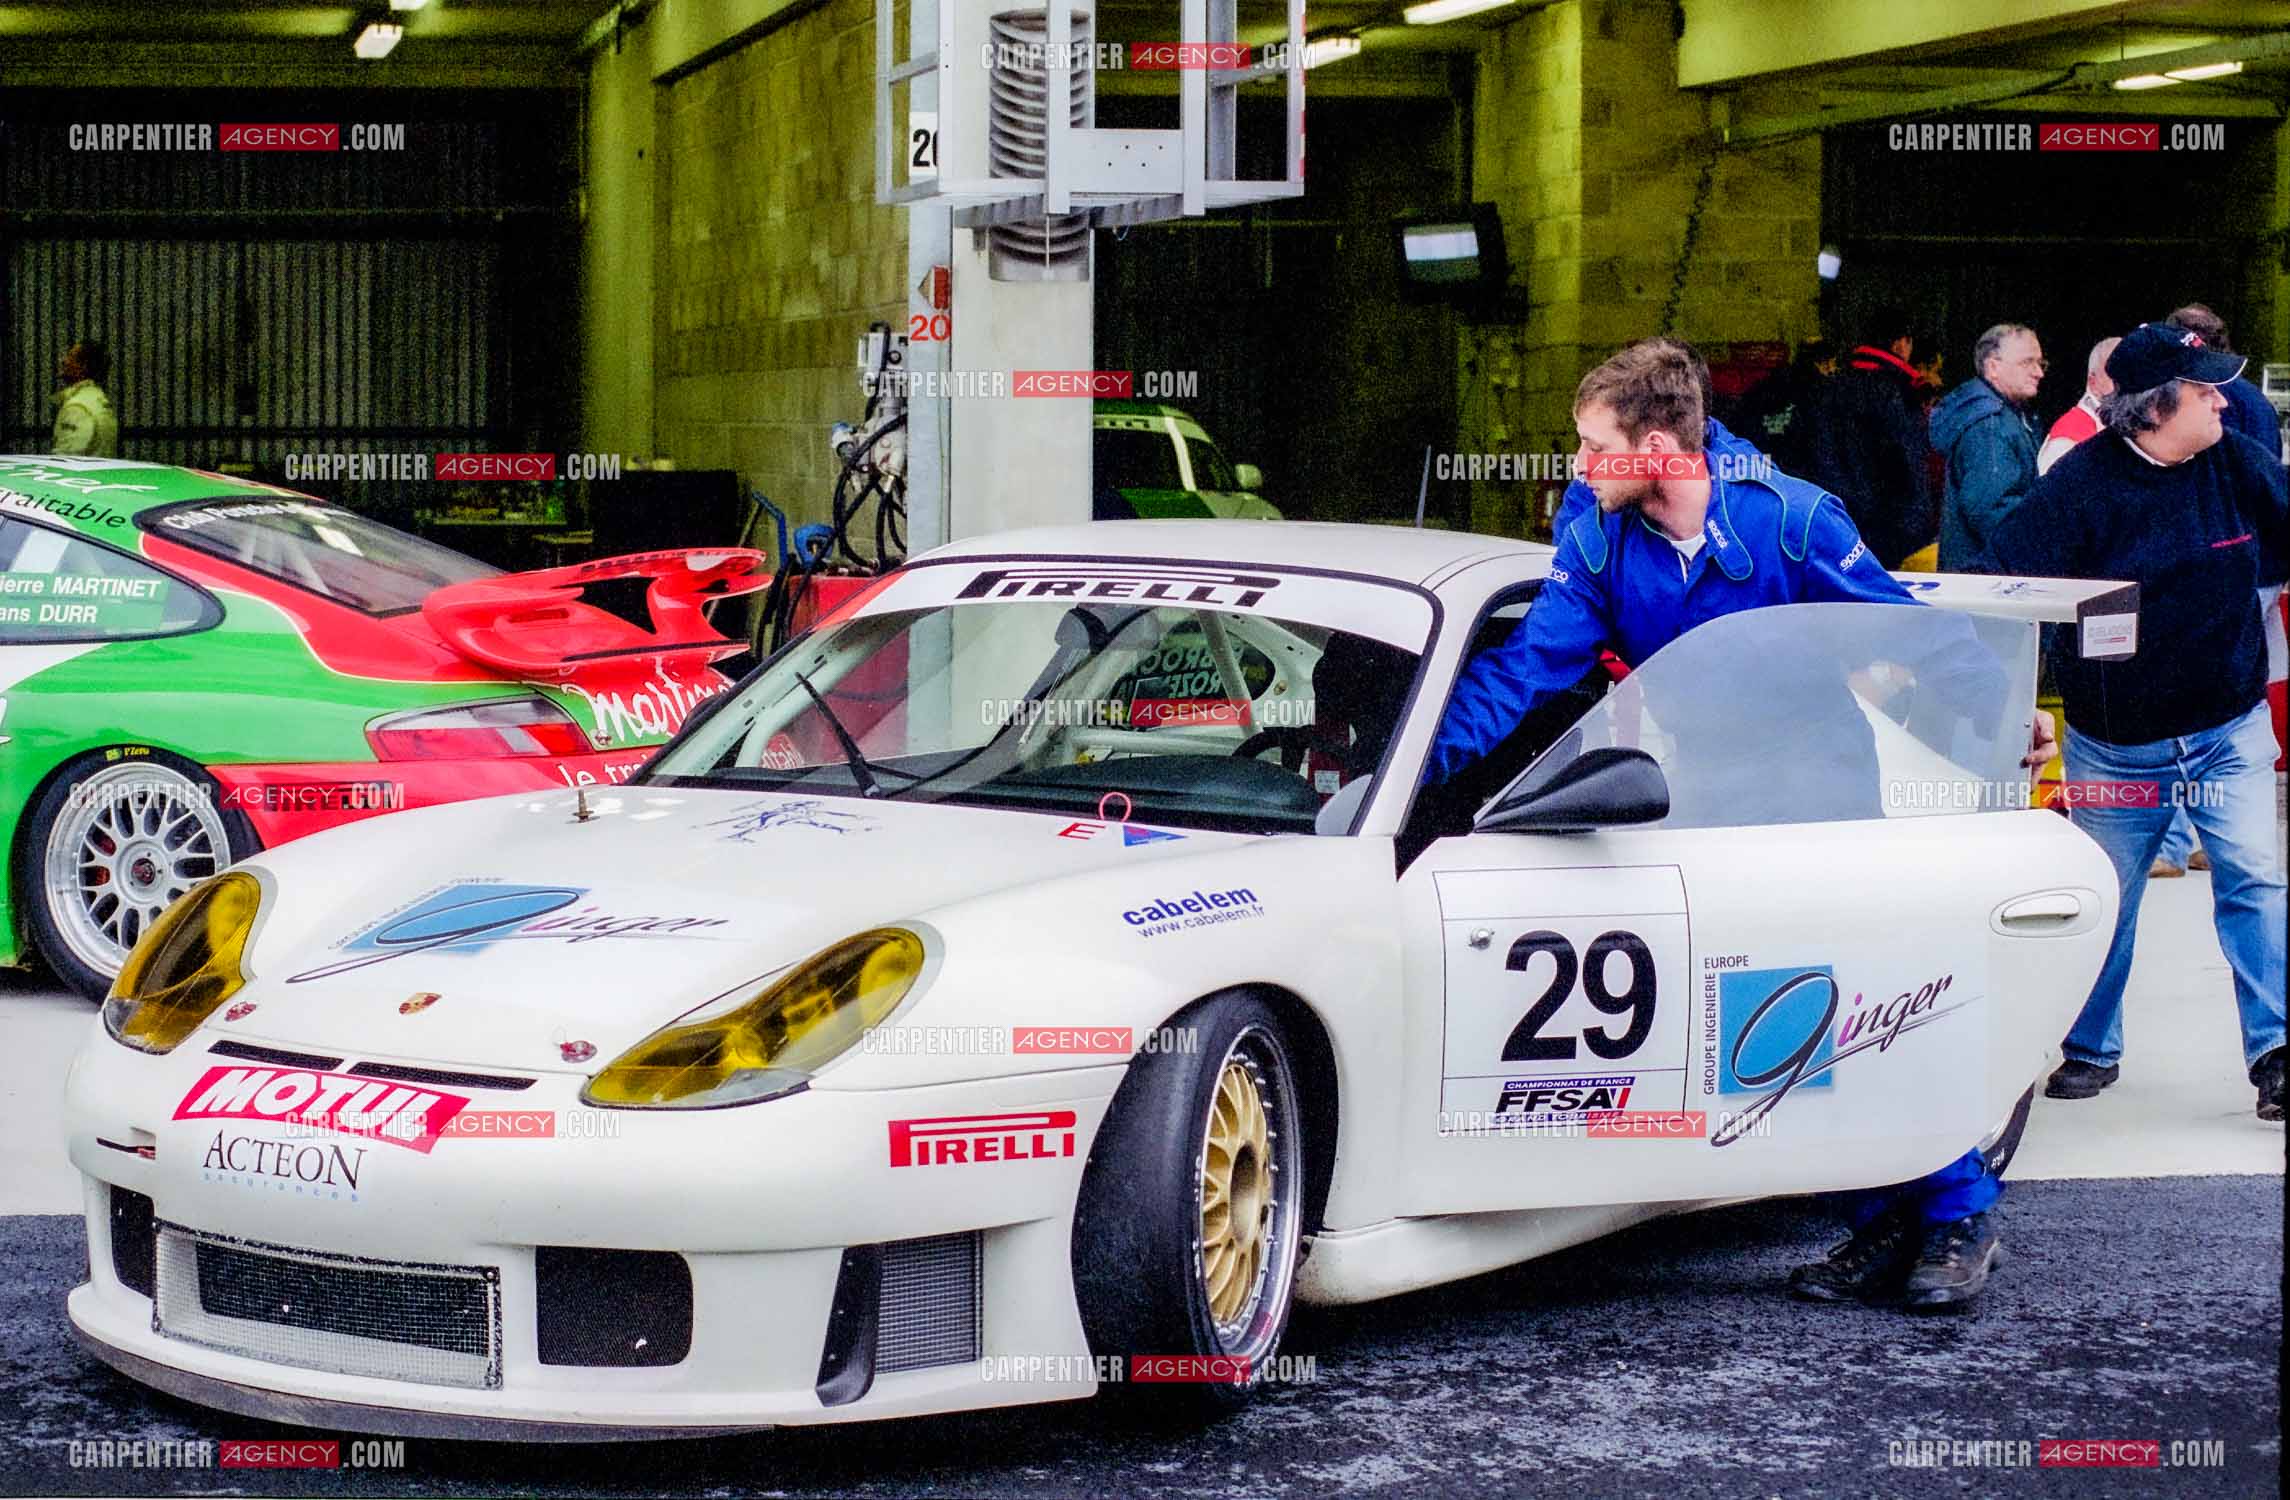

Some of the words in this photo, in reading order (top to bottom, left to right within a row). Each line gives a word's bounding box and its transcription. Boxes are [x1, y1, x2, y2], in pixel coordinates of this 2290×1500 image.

[910, 314, 951, 341] 20
[53, 577, 161, 597] MARTINET
[956, 568, 1281, 607] PIRELLI
[40, 604, 97, 623] DURR
[1122, 888, 1257, 925] cabelem
[1137, 904, 1264, 938] www.cabelem.fr
[1704, 955, 1749, 970] EUROPE
[1501, 929, 1657, 1062] 29
[1704, 973, 1716, 1042] INGENIERIE
[1703, 1045, 1716, 1095] GROUPE
[1711, 972, 1953, 1147] ginger
[187, 1069, 441, 1143] MOTUL
[203, 1129, 368, 1190] ACTEON
[888, 1111, 1076, 1167] PIRELLI
